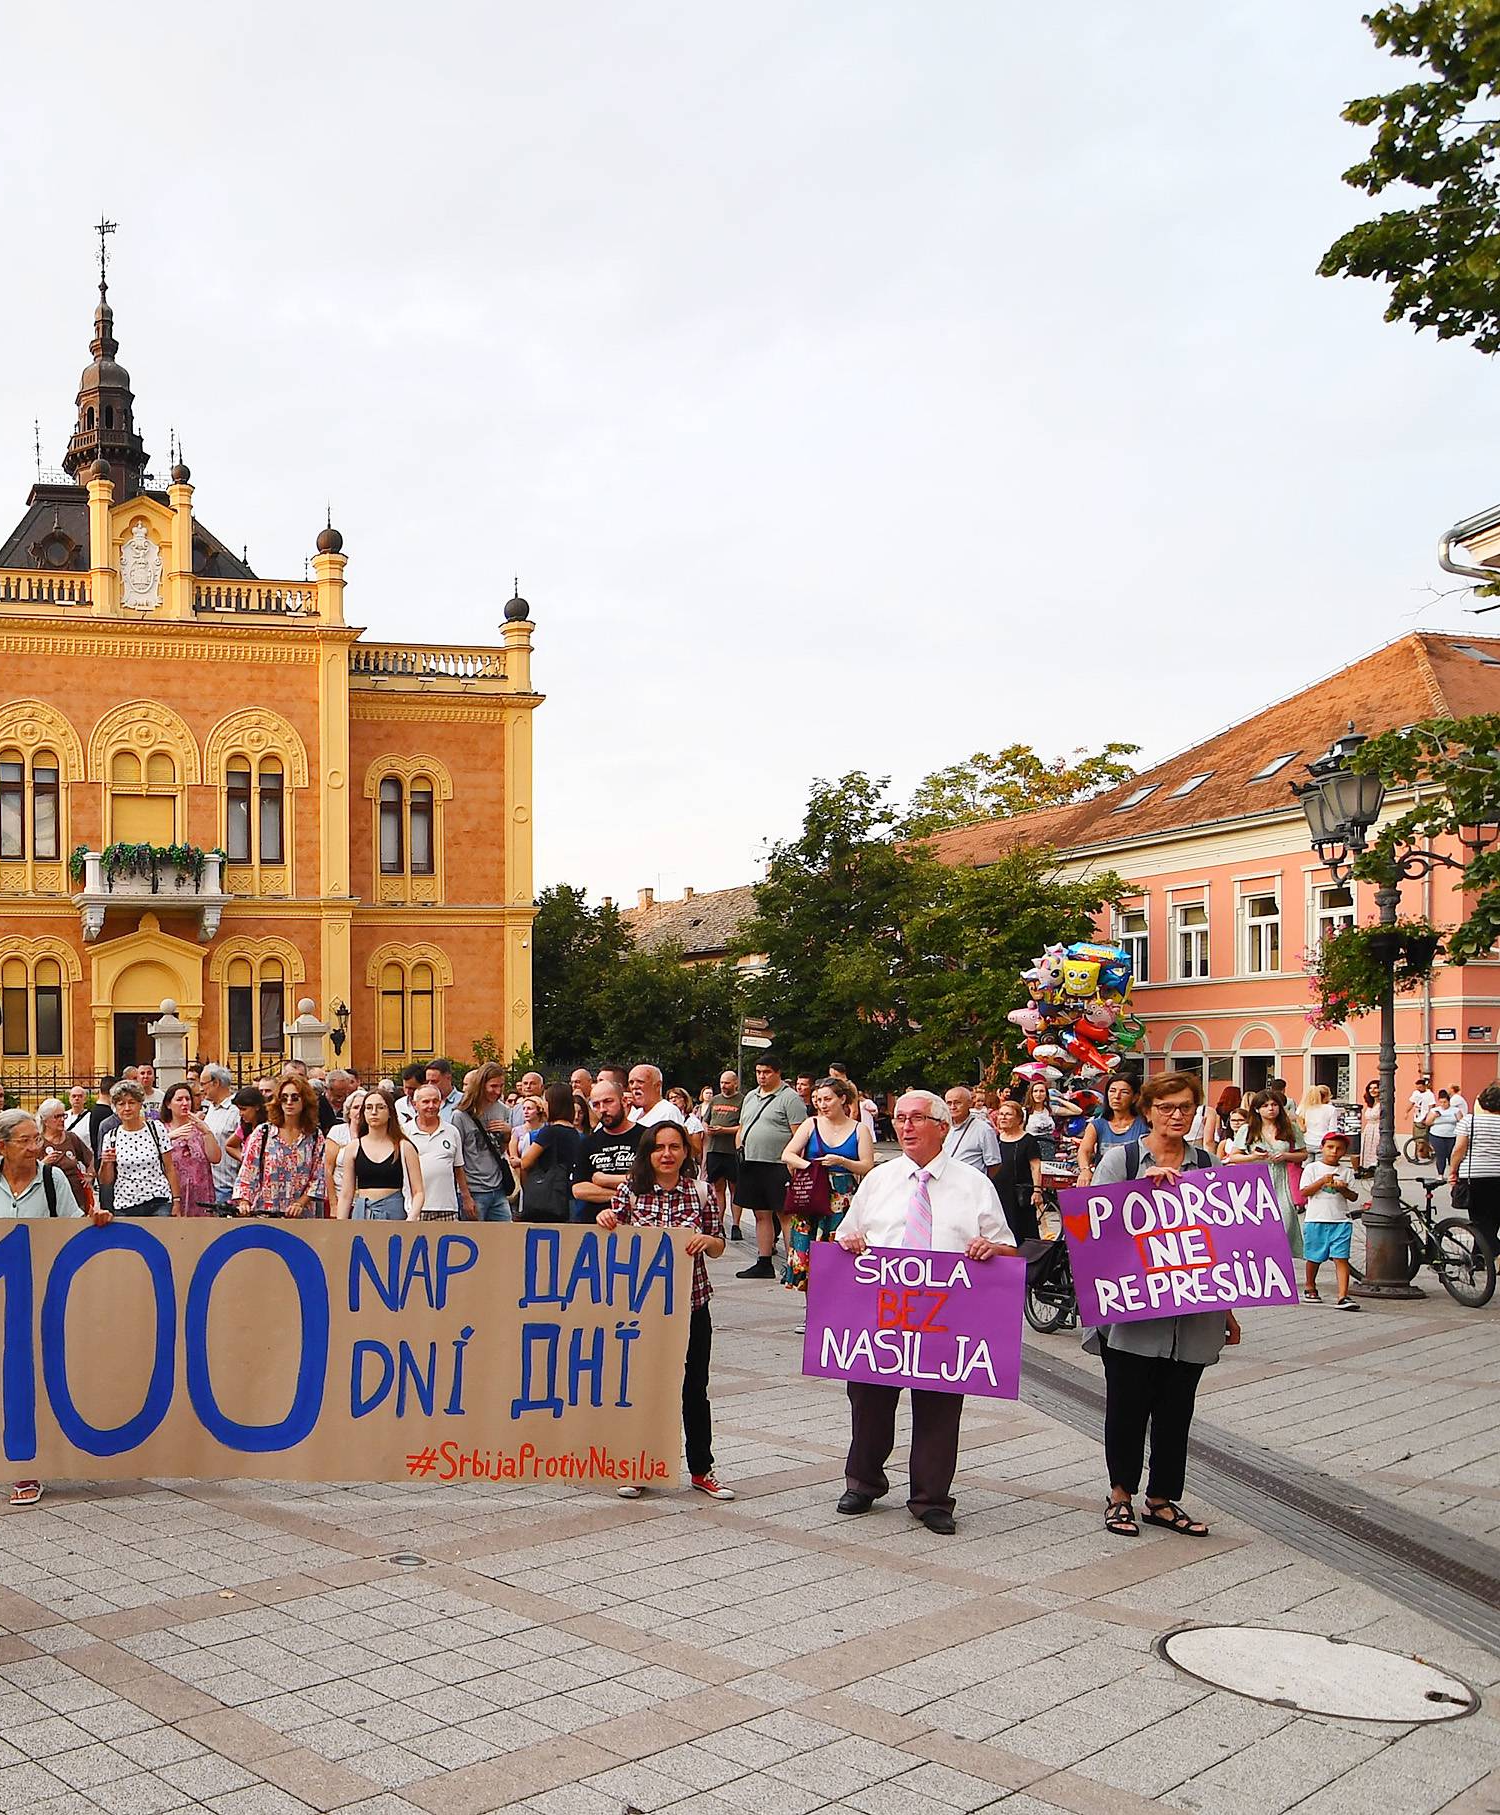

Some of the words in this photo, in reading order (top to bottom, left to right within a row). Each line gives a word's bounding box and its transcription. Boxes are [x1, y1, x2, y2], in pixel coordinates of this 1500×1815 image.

[589, 1152, 612, 1166] Tom
[613, 1150, 636, 1163] Tail
[853, 1248, 972, 1289] ŠKOLA
[1147, 1228, 1212, 1268] NE
[349, 1233, 479, 1313] NAP
[518, 1227, 674, 1316] ДАНА
[877, 1288, 949, 1333] BEZ
[820, 1327, 998, 1387] NASILJA
[406, 1441, 670, 1481] #SrbijaProtivNasilja
